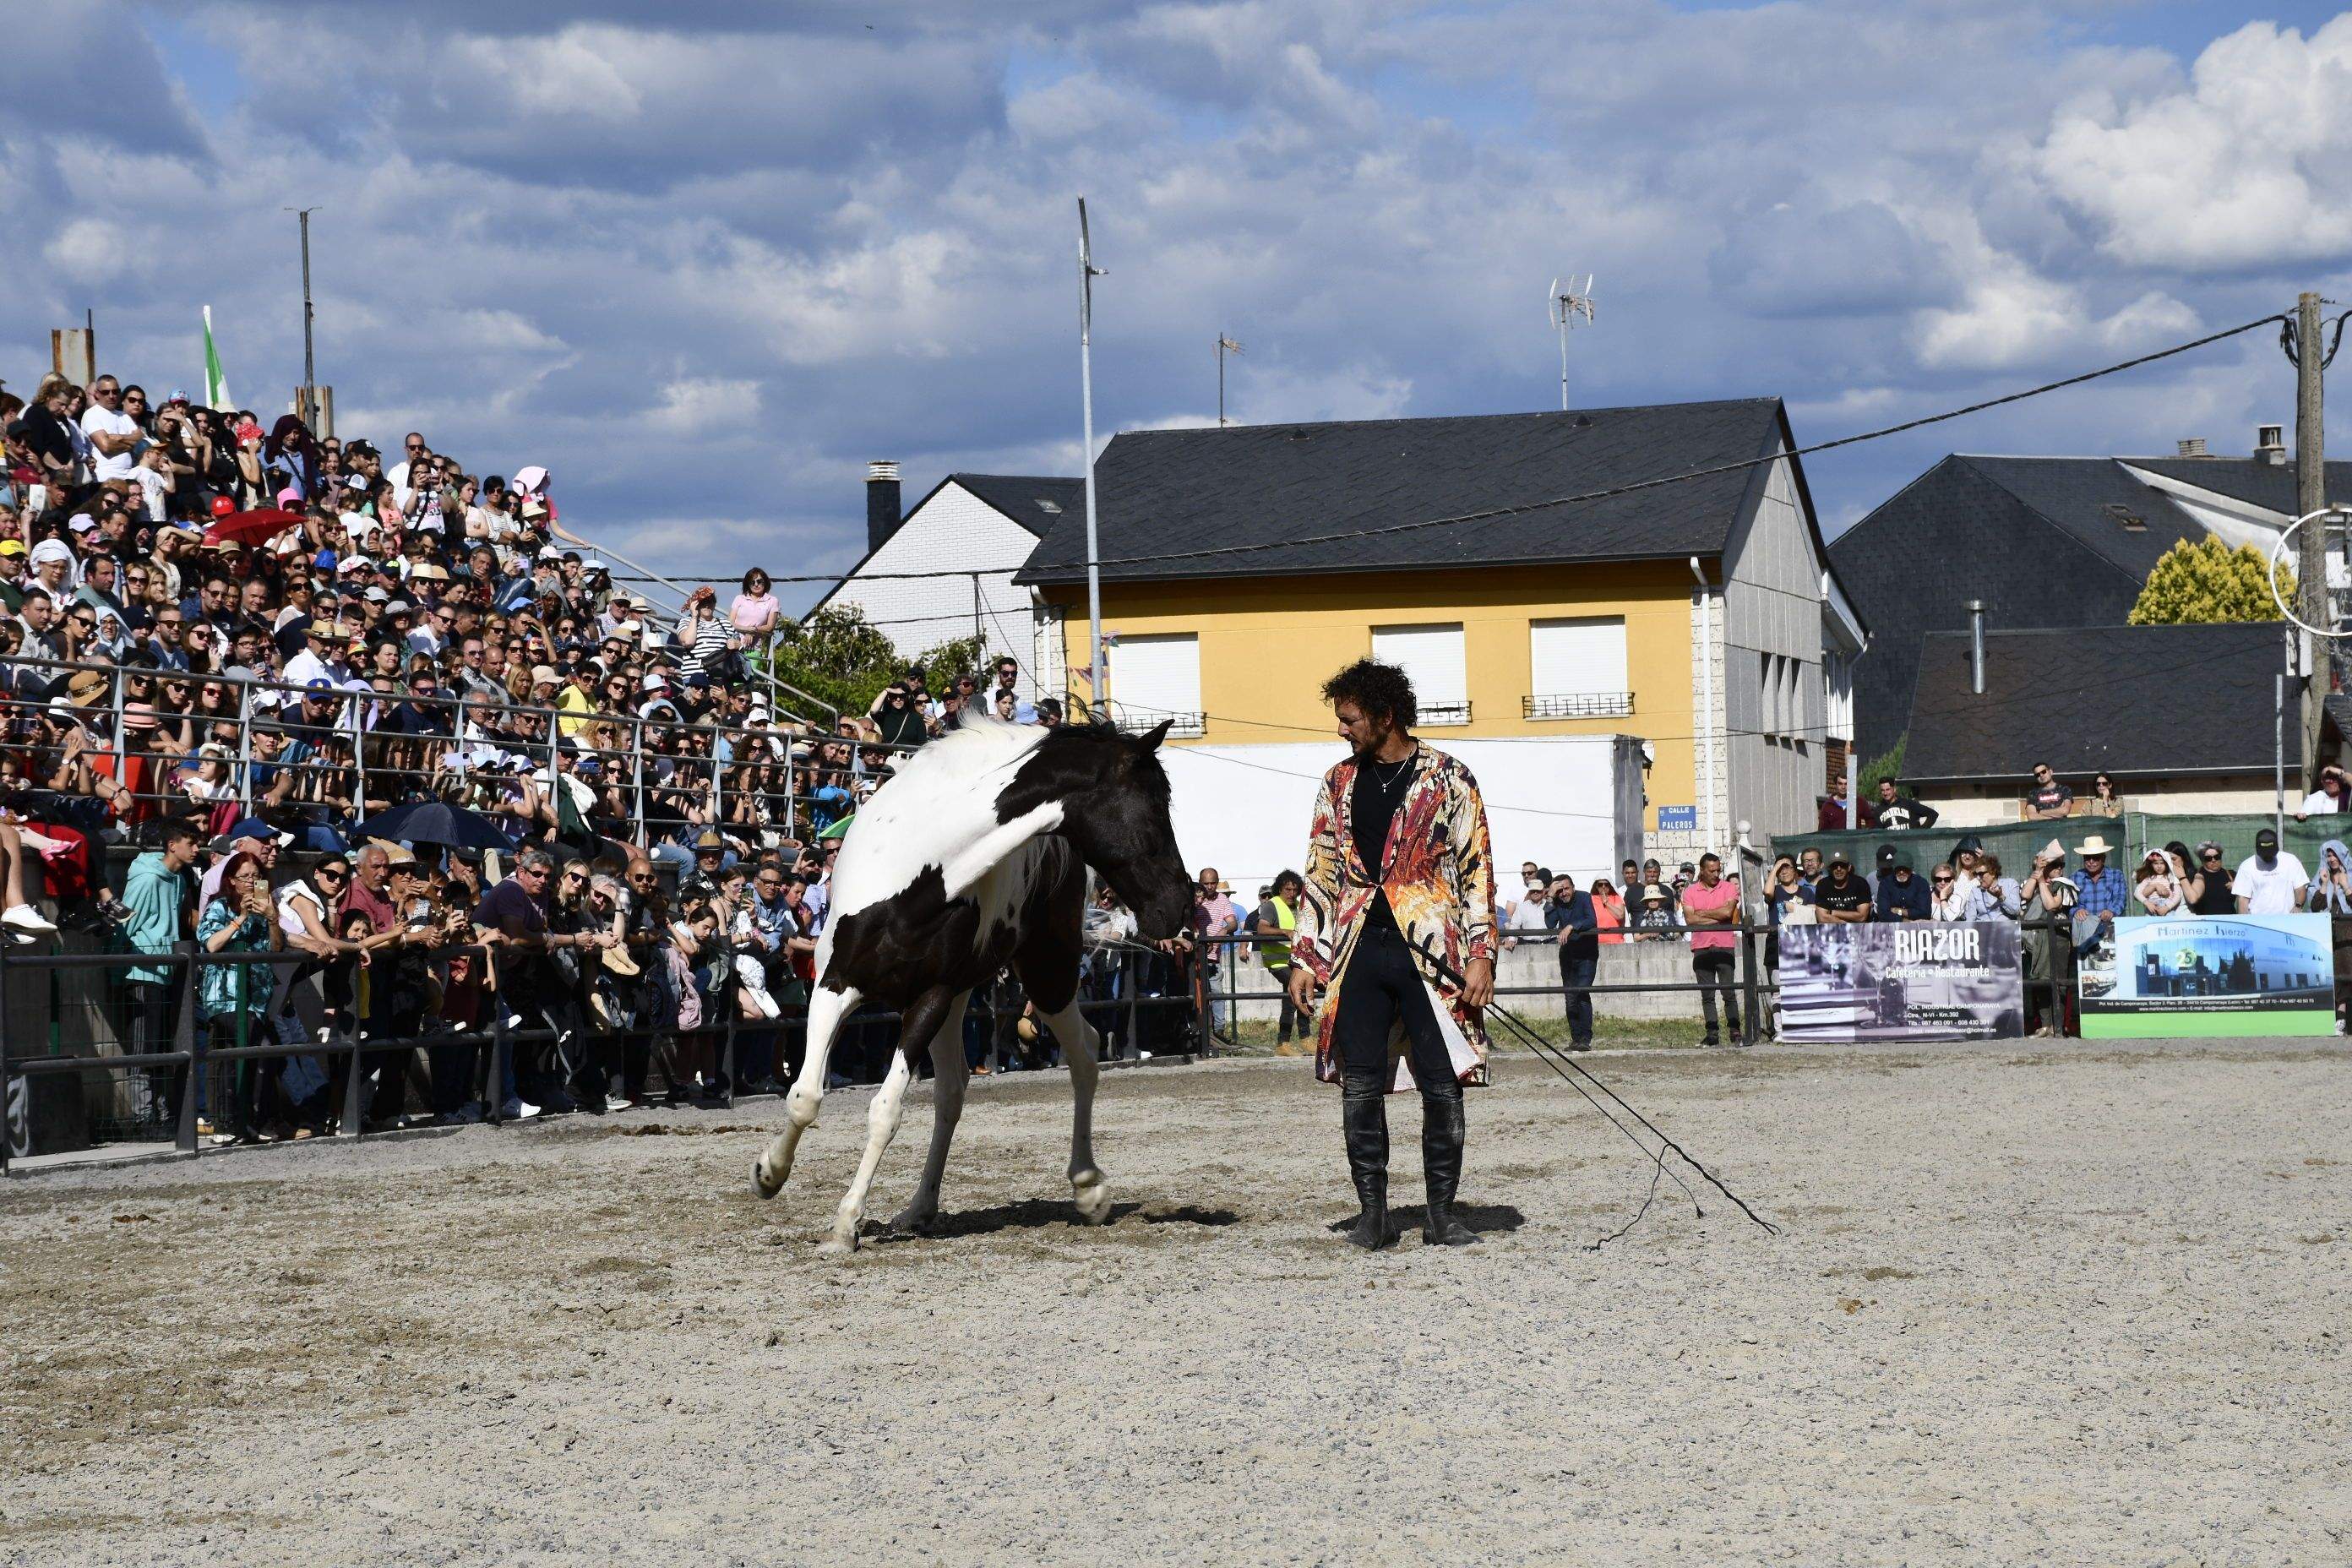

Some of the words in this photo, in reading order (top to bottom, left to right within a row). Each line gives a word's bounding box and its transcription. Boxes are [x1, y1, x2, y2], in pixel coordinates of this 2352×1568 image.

[1662, 820, 1693, 830] PALEROS
[1894, 928, 1980, 961] RIAZOR
[1935, 965, 1990, 978] Restaurante
